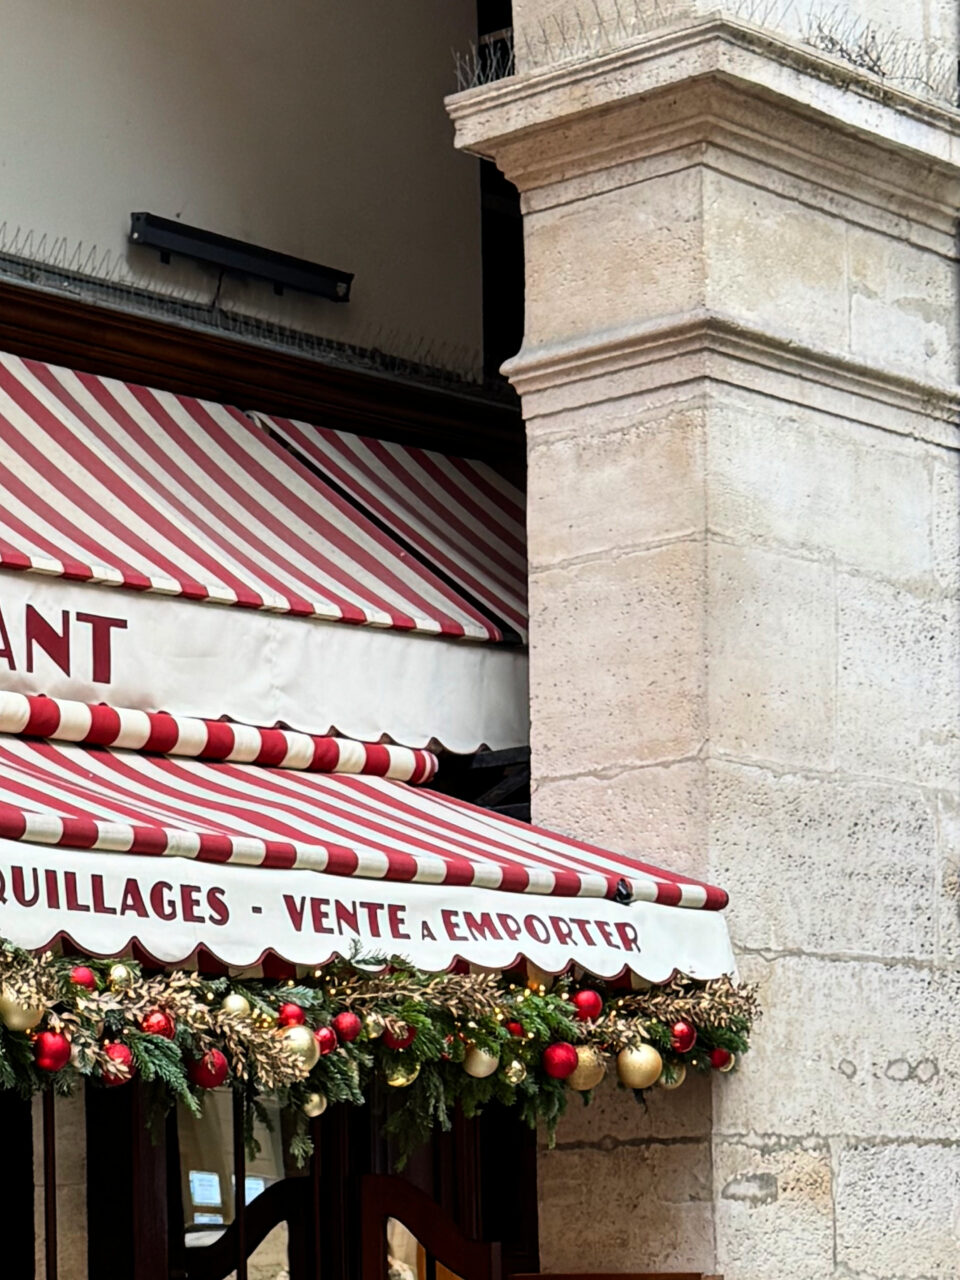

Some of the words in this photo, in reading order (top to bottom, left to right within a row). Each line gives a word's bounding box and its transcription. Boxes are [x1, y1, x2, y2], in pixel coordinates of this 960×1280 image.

[283, 894, 410, 940] VENTE
[421, 920, 437, 941] A
[441, 909, 641, 953] EMPORTER
